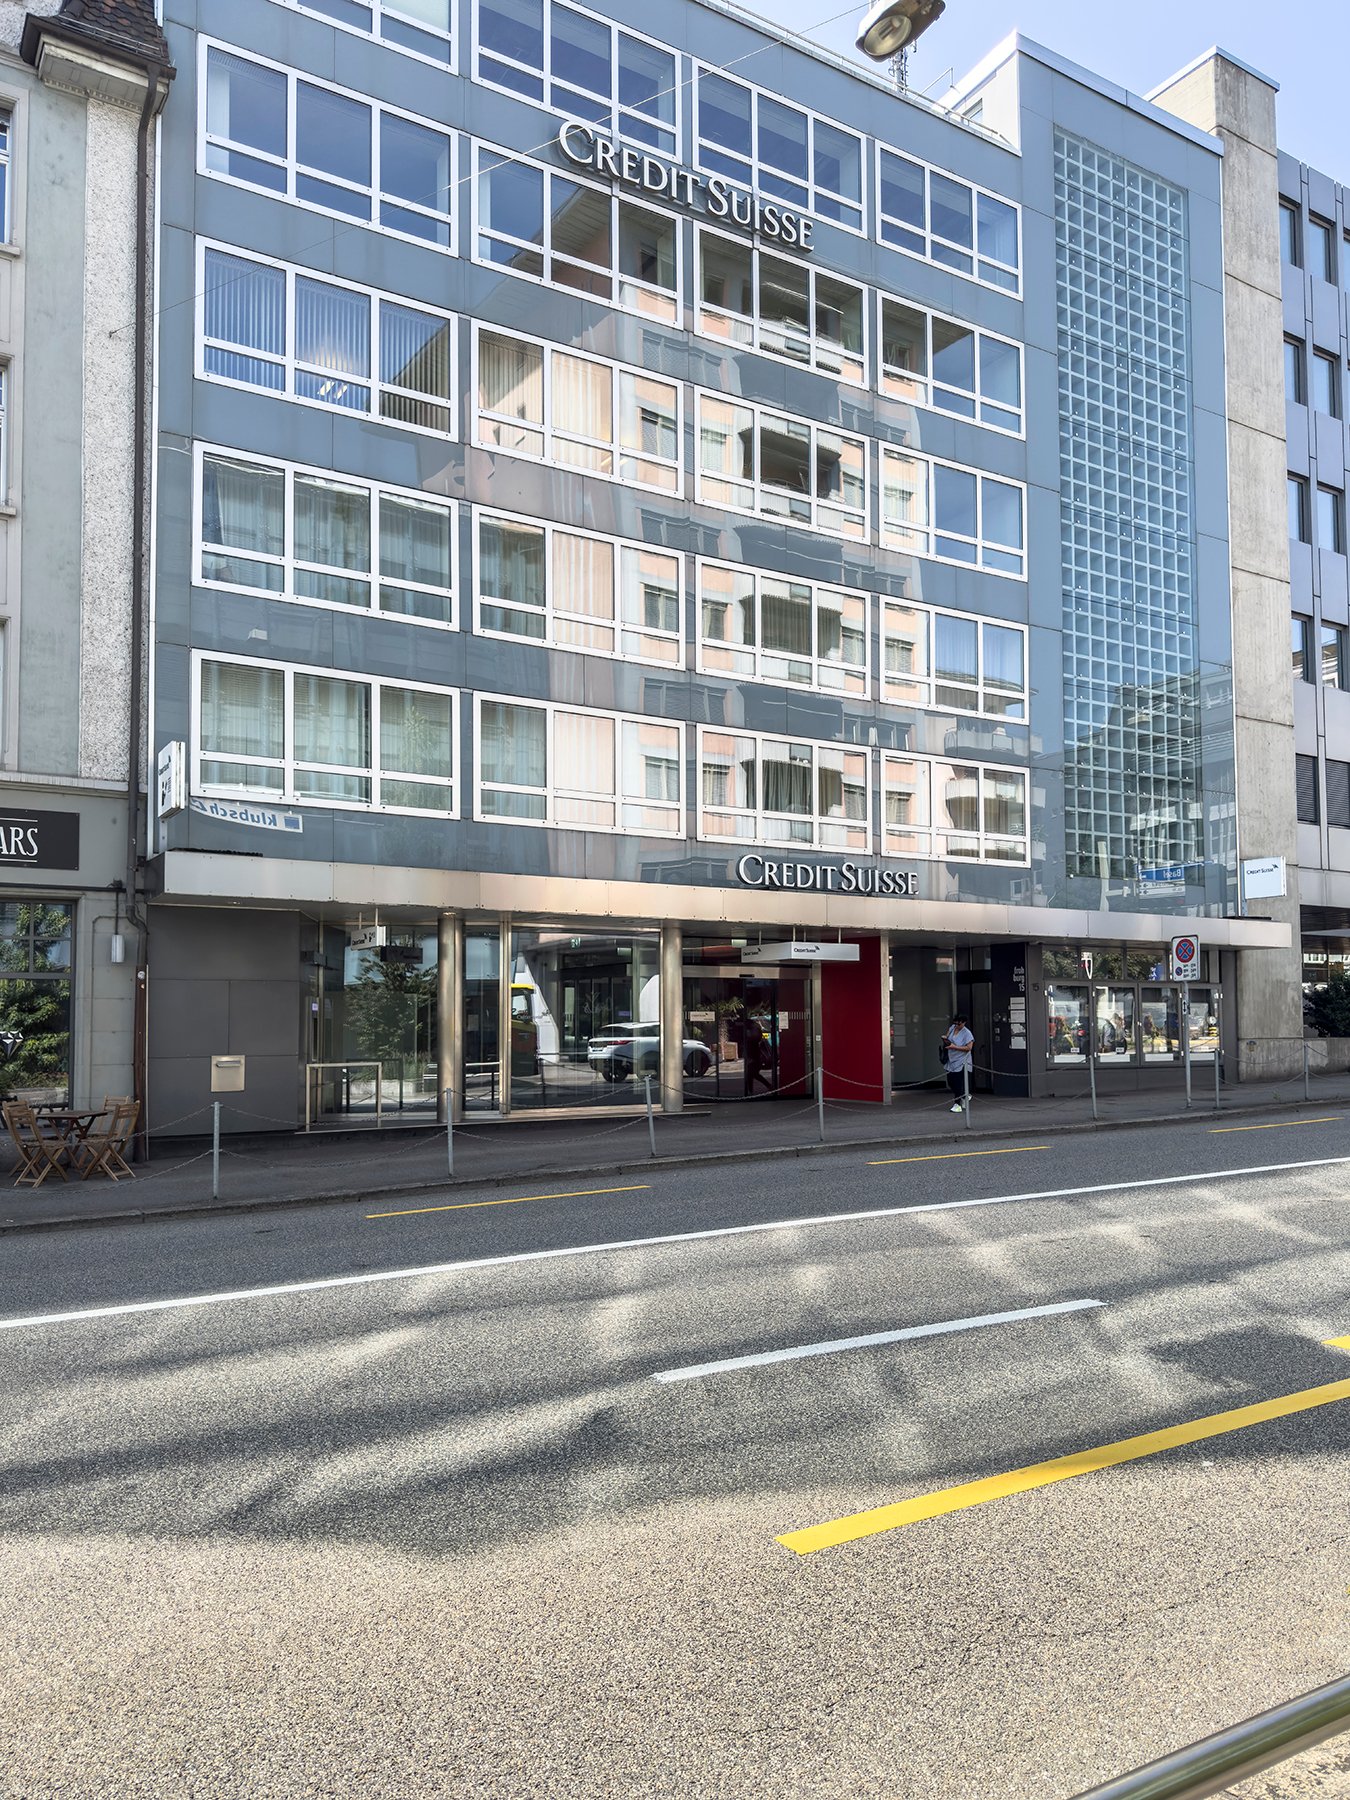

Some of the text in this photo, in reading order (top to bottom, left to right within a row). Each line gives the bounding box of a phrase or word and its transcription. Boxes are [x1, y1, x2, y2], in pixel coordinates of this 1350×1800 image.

[559, 121, 815, 252] CREDIT SUISSE
[737, 854, 920, 895] CREDIT SUISSE
[1018, 983, 1025, 991] 15
